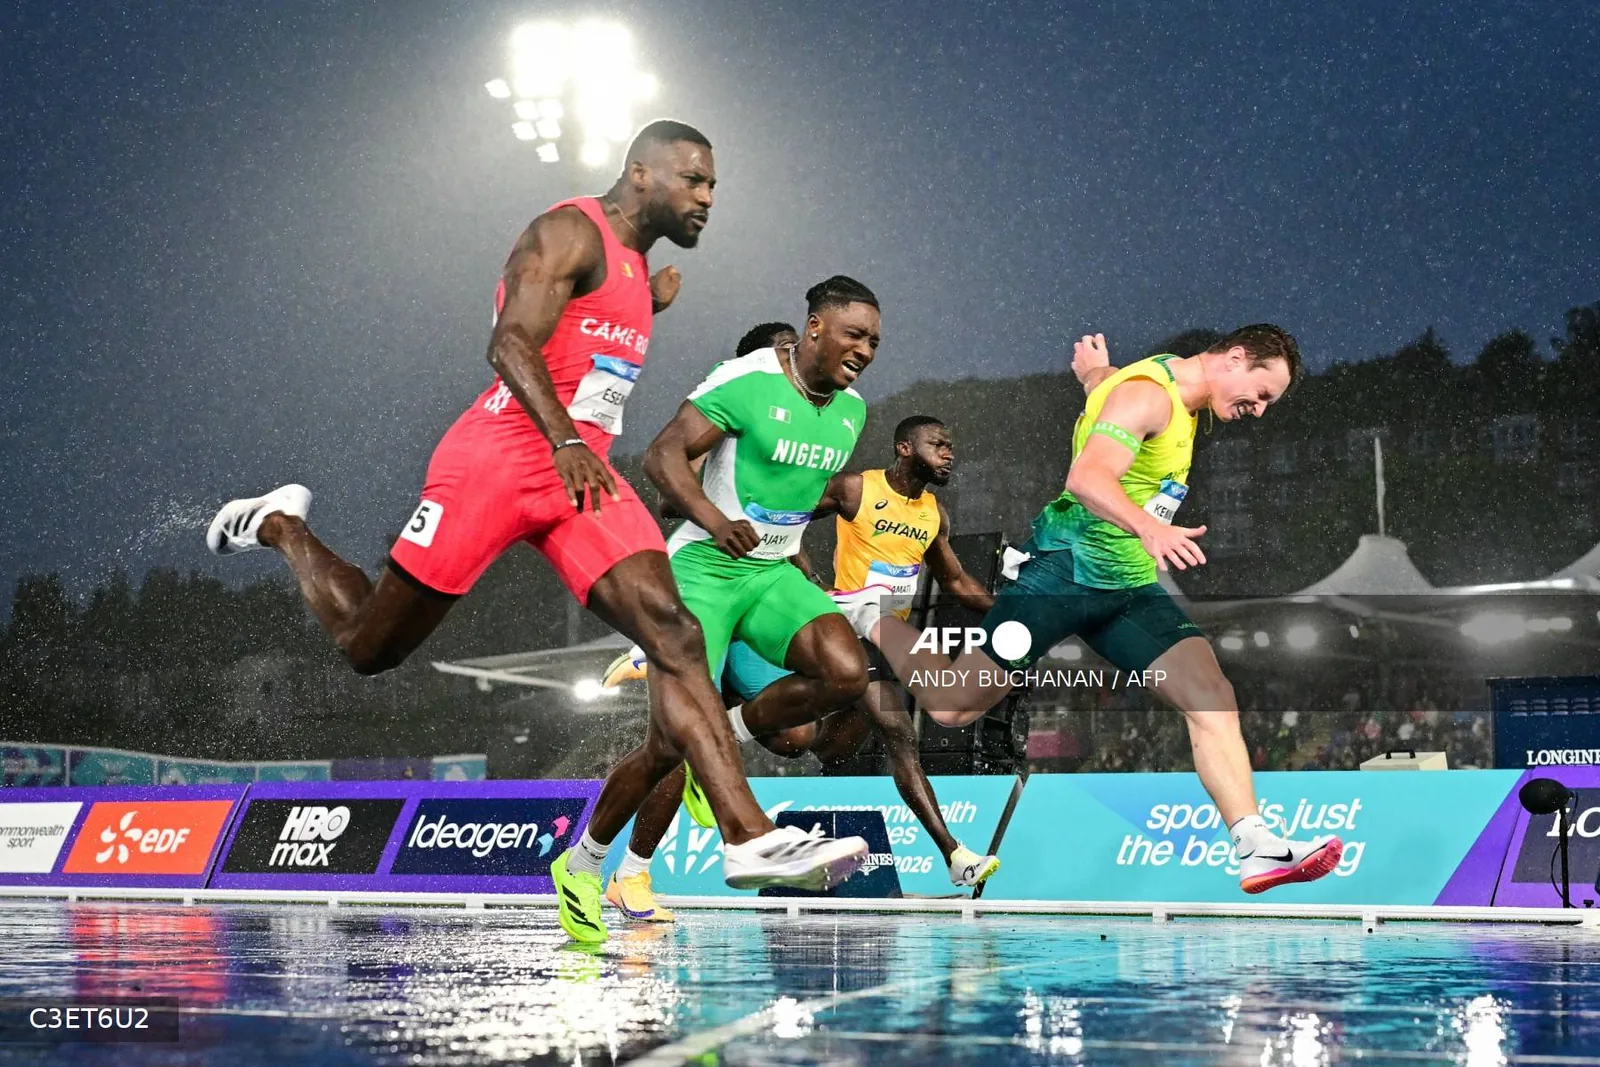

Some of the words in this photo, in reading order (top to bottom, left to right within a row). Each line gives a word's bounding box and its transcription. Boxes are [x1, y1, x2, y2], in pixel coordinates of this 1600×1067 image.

[411, 506, 430, 533] 5
[875, 519, 928, 541] GHANA
[760, 533, 788, 545] AJAYI
[279, 805, 351, 841] HBO
[1146, 803, 1223, 835] spor
[1287, 798, 1362, 836] just
[7, 837, 35, 850] sport
[408, 815, 538, 857] Ideagen
[269, 842, 337, 867] max
[1115, 835, 1177, 866] the
